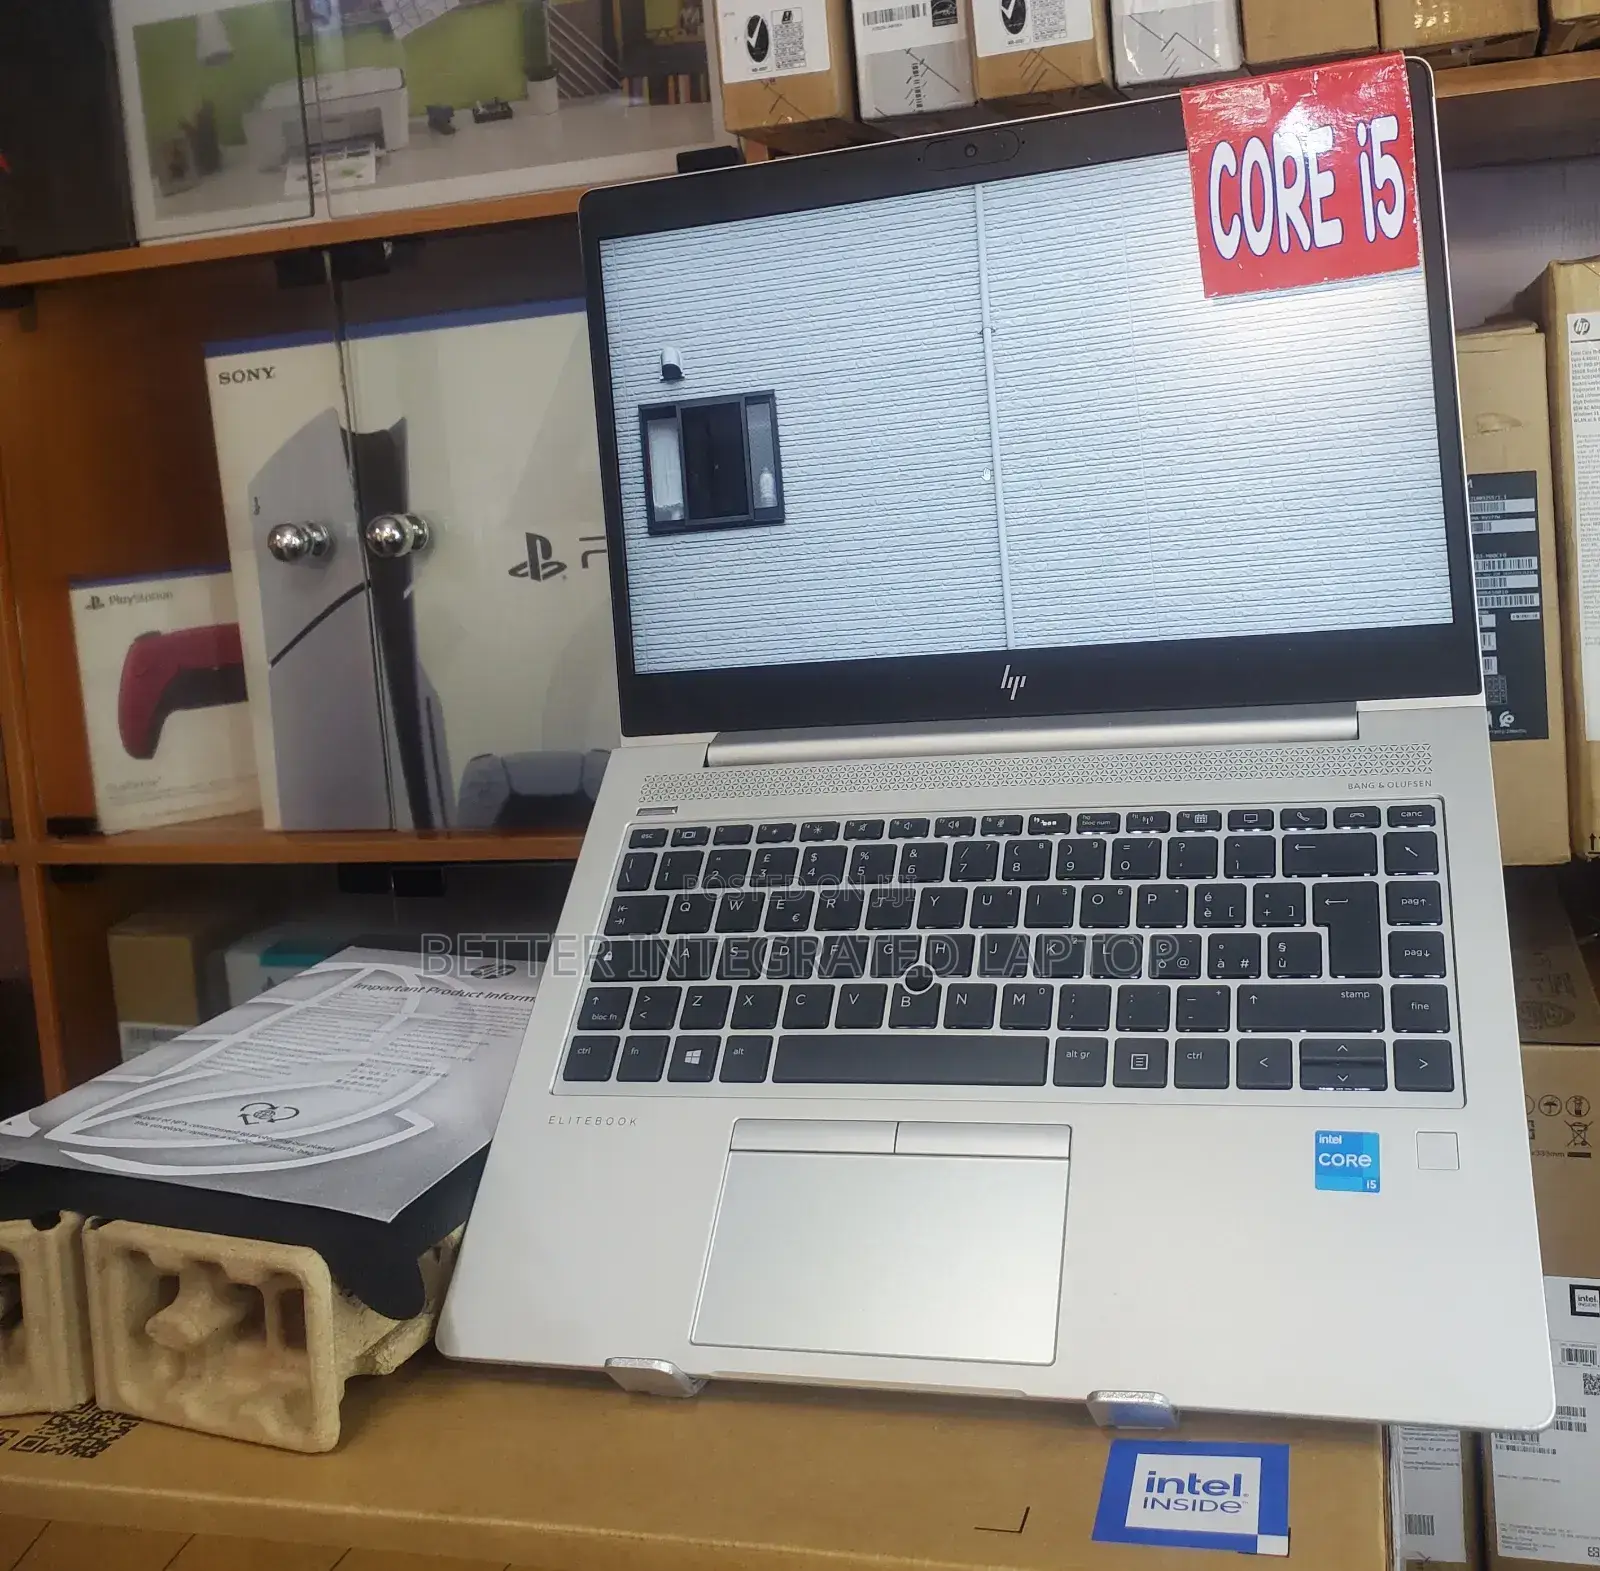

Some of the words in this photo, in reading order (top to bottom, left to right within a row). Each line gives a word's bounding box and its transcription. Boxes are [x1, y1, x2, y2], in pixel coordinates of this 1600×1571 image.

[1208, 125, 1344, 260] CORE
[1355, 114, 1406, 243] i5
[1573, 318, 1591, 335] hp
[218, 366, 275, 386] SONY
[1001, 665, 1026, 700] hp
[1348, 782, 1375, 790] BANG
[1387, 780, 1432, 789] OLUFSEN
[1092, 841, 1099, 849] 9
[1178, 843, 1186, 852] ?
[811, 853, 817, 863] $
[860, 851, 870, 860] %
[909, 849, 918, 858] &
[960, 847, 969, 859] /
[763, 854, 771, 863] £
[857, 866, 865, 876] 5
[907, 865, 916, 874] 6
[960, 863, 968, 873] 7
[1012, 862, 1021, 872] 8
[1066, 861, 1075, 871] 9
[664, 872, 669, 881] 1
[711, 870, 719, 880] 2
[759, 869, 767, 878] 3
[808, 868, 815, 877] 4
[930, 896, 940, 907] Y
[982, 895, 993, 906] U
[1147, 893, 1157, 904] P
[1204, 892, 1212, 901] é
[680, 902, 691, 912] Q
[729, 901, 744, 911] W
[776, 900, 785, 910] E
[826, 899, 836, 909] R
[792, 913, 800, 922] €
[1204, 908, 1212, 917] è
[729, 946, 739, 957] S
[779, 945, 790, 955] D
[829, 945, 839, 955] F
[883, 943, 893, 954] G
[935, 944, 946, 954] H
[989, 943, 998, 954] J
[1046, 943, 1057, 954] K
[1102, 943, 1111, 954] L
[1278, 942, 1286, 952] §
[680, 948, 691, 958] A
[1176, 957, 1190, 969] @
[1217, 958, 1225, 968] à
[1240, 958, 1250, 968] #
[1278, 957, 1287, 968] ù
[353, 982, 426, 994] Important
[428, 987, 484, 998] Product
[485, 991, 536, 1002] Inform
[1340, 989, 1370, 1000] stamp
[692, 995, 703, 1006] Z
[743, 994, 755, 1006] X
[795, 994, 806, 1005] C
[849, 993, 860, 1005] V
[900, 996, 911, 1007] B
[956, 993, 968, 1005] N
[1013, 993, 1026, 1005] M
[1410, 1002, 1430, 1010] fine
[591, 1013, 608, 1021] bloc
[609, 1013, 618, 1021] fn
[577, 1047, 592, 1055] ctrl
[630, 1047, 639, 1055] fn
[732, 1047, 744, 1055] alt
[1066, 1050, 1078, 1058] alt
[1080, 1051, 1090, 1060] gr
[1186, 1052, 1202, 1060] ctrl
[548, 1115, 638, 1126] ELITEBOOK
[1319, 1134, 1343, 1144] intel
[1366, 1179, 1377, 1189] i5
